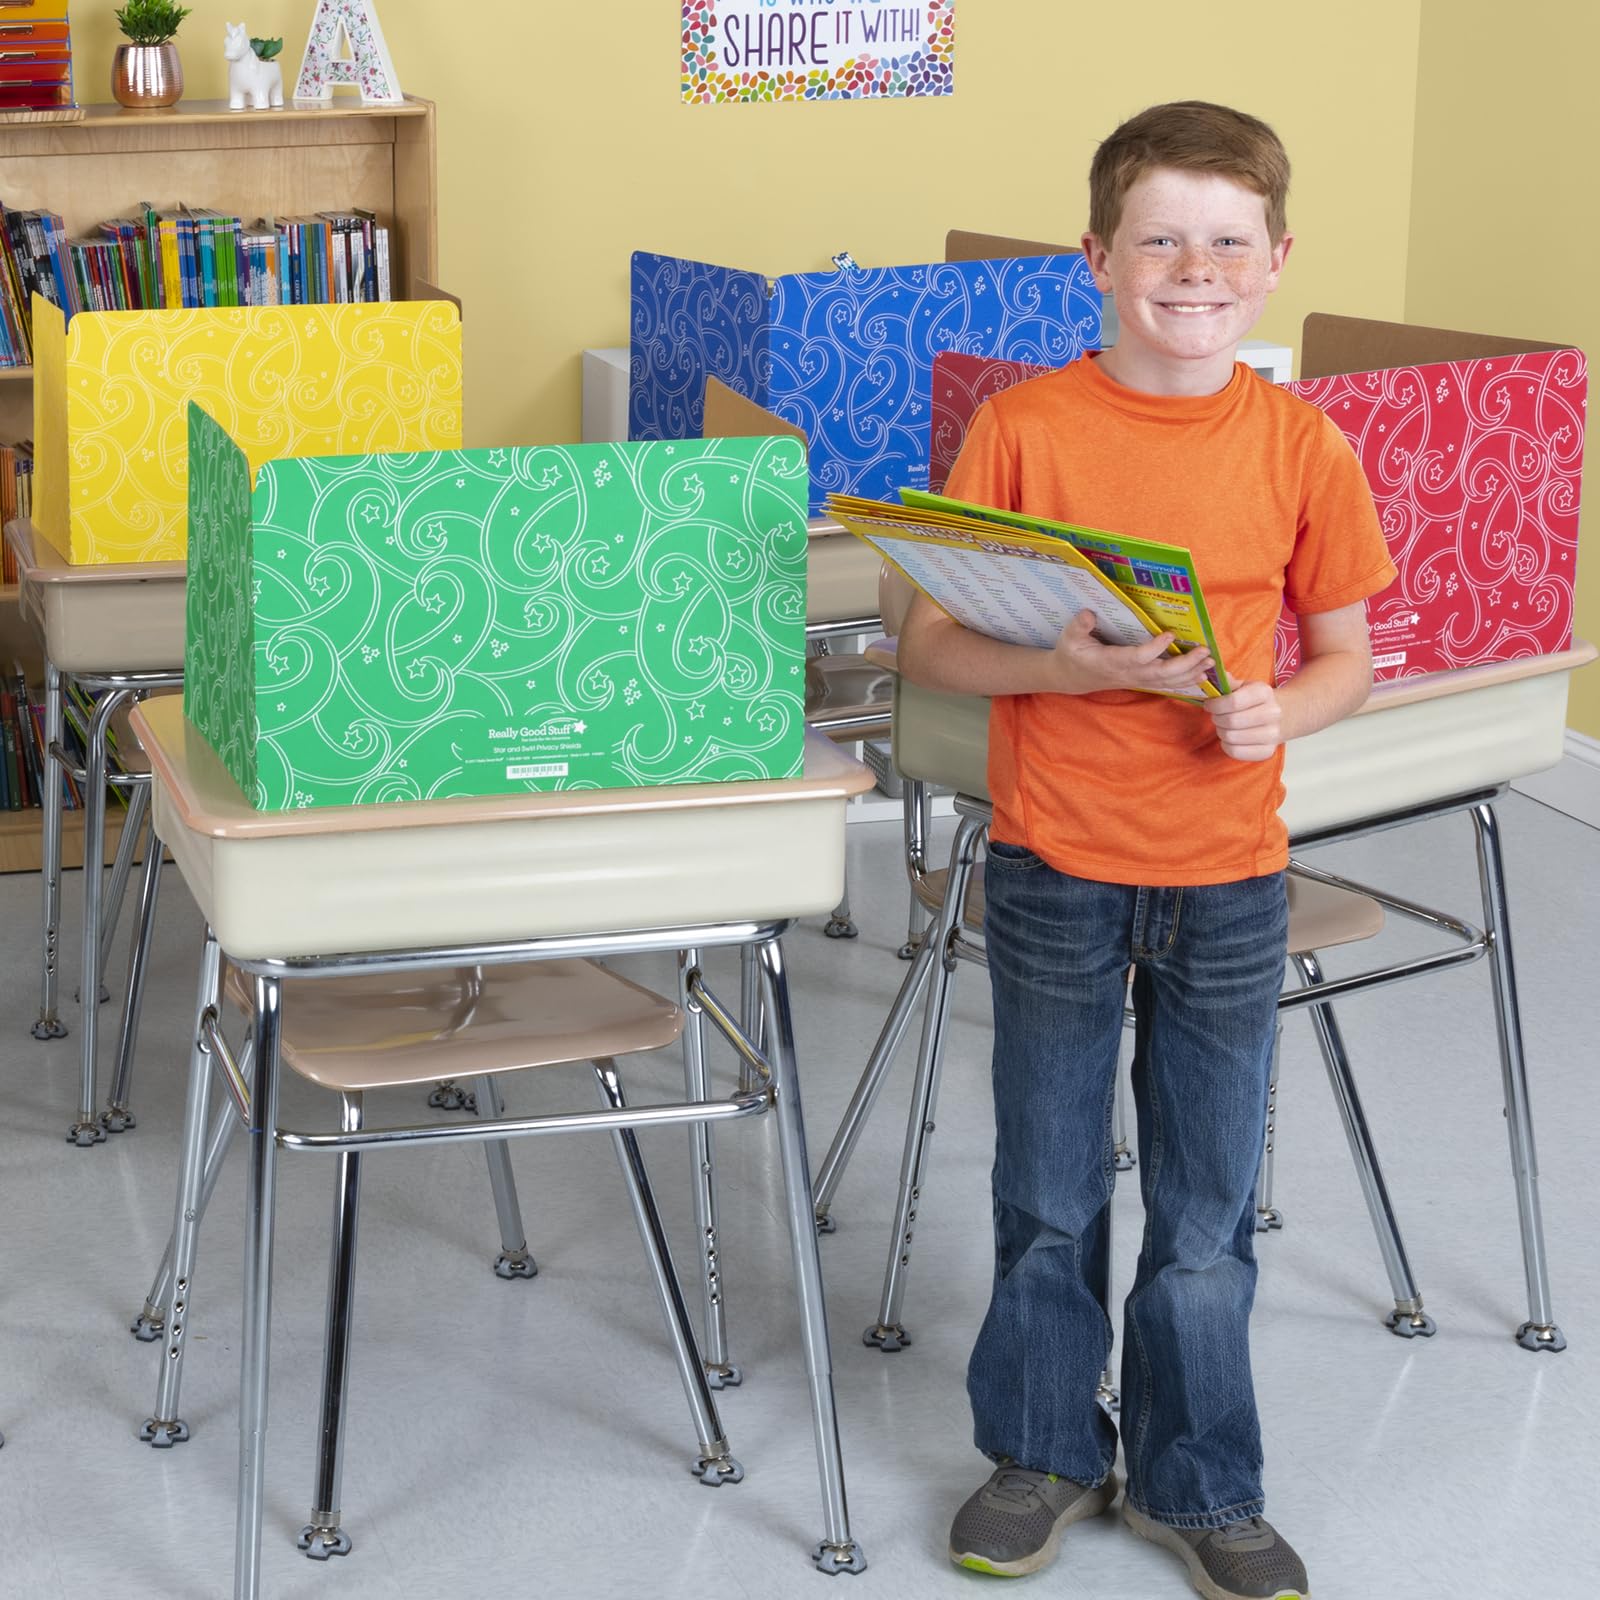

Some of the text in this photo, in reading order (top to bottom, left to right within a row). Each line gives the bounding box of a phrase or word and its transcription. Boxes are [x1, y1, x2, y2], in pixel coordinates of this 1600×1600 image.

[723, 8, 921, 67] SHARE IT WITH!
[293, 0, 405, 103] A
[1135, 561, 1182, 575] decimals
[1373, 619, 1392, 631] Good
[488, 726, 519, 740] Really
[519, 724, 547, 737] Good
[548, 723, 571, 736] Stuff
[493, 746, 507, 754] Star
[506, 745, 521, 753] and
[536, 743, 559, 753] Privacy
